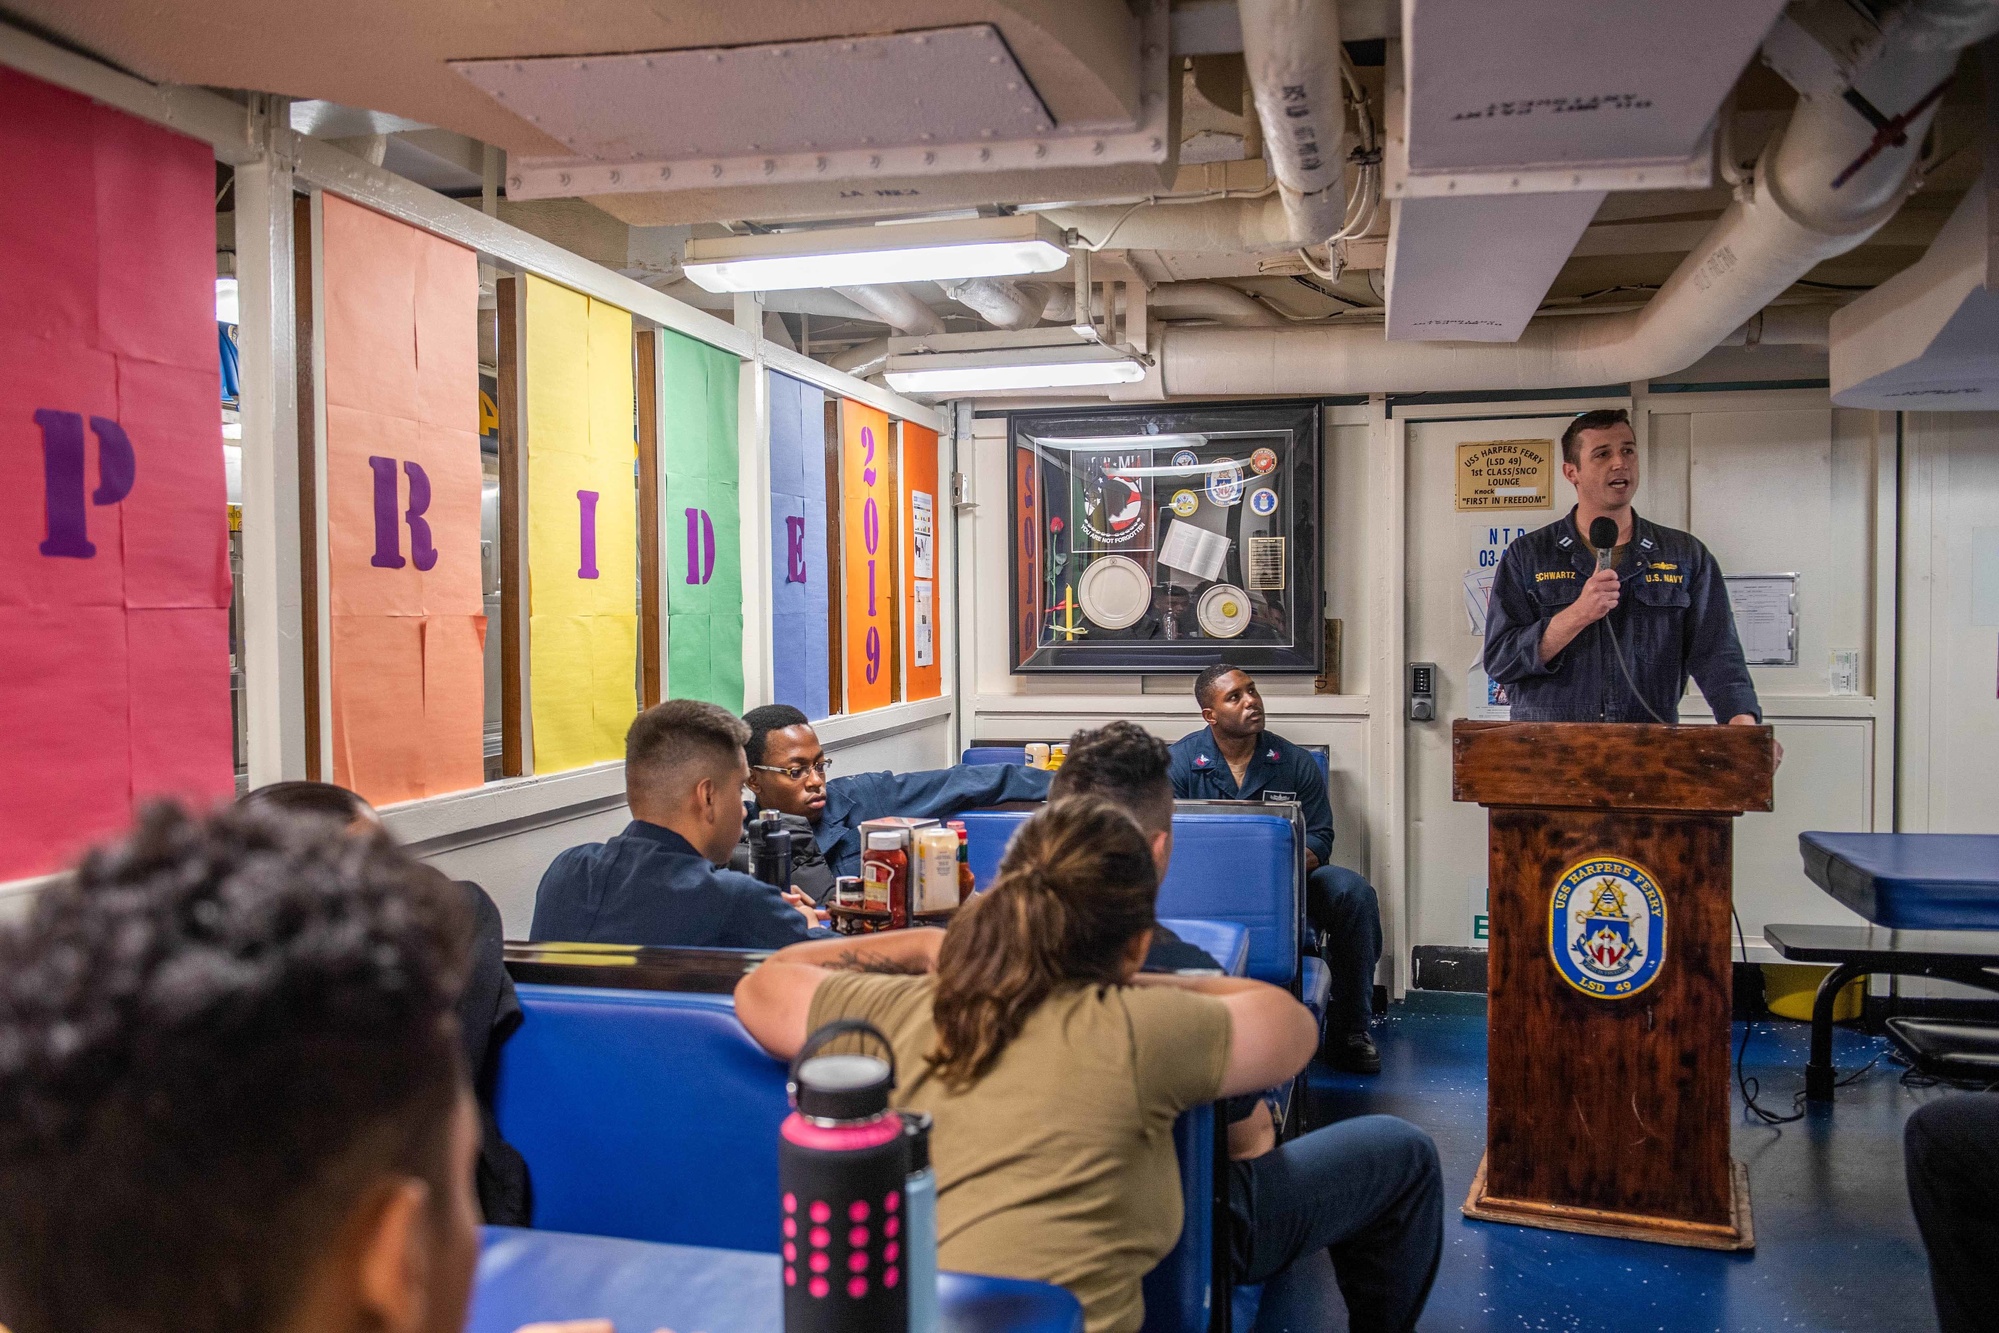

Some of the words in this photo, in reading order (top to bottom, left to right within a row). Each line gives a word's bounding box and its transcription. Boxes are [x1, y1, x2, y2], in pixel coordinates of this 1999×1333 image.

[1464, 454, 1480, 468] USS
[1480, 446, 1518, 458] HARPERS
[1519, 448, 1544, 465] FERRY
[1486, 458, 1506, 468] (LSD
[1508, 456, 1522, 466] 49)
[1471, 469, 1483, 477] 1st
[1486, 467, 1538, 477] CLASS/SNCO
[1487, 478, 1520, 486] LOUNGE
[1462, 497, 1488, 505] "FIRST
[1503, 495, 1546, 504] FREEDOM"
[1081, 524, 1091, 535] YOU
[1090, 533, 1102, 542] ARE
[1114, 522, 1146, 543] FORGOTTEN
[860, 426, 881, 685] 2019
[1479, 549, 1506, 567] 03-
[1535, 571, 1575, 582] SCHWARTZ
[1645, 573, 1663, 583] U.S.
[1664, 573, 1684, 583] NAVY
[1555, 885, 1571, 909] USS
[1568, 863, 1632, 884] HARPERS
[1634, 874, 1662, 917] FERRY
[1579, 976, 1605, 993] LSD
[1615, 981, 1632, 992] 49
